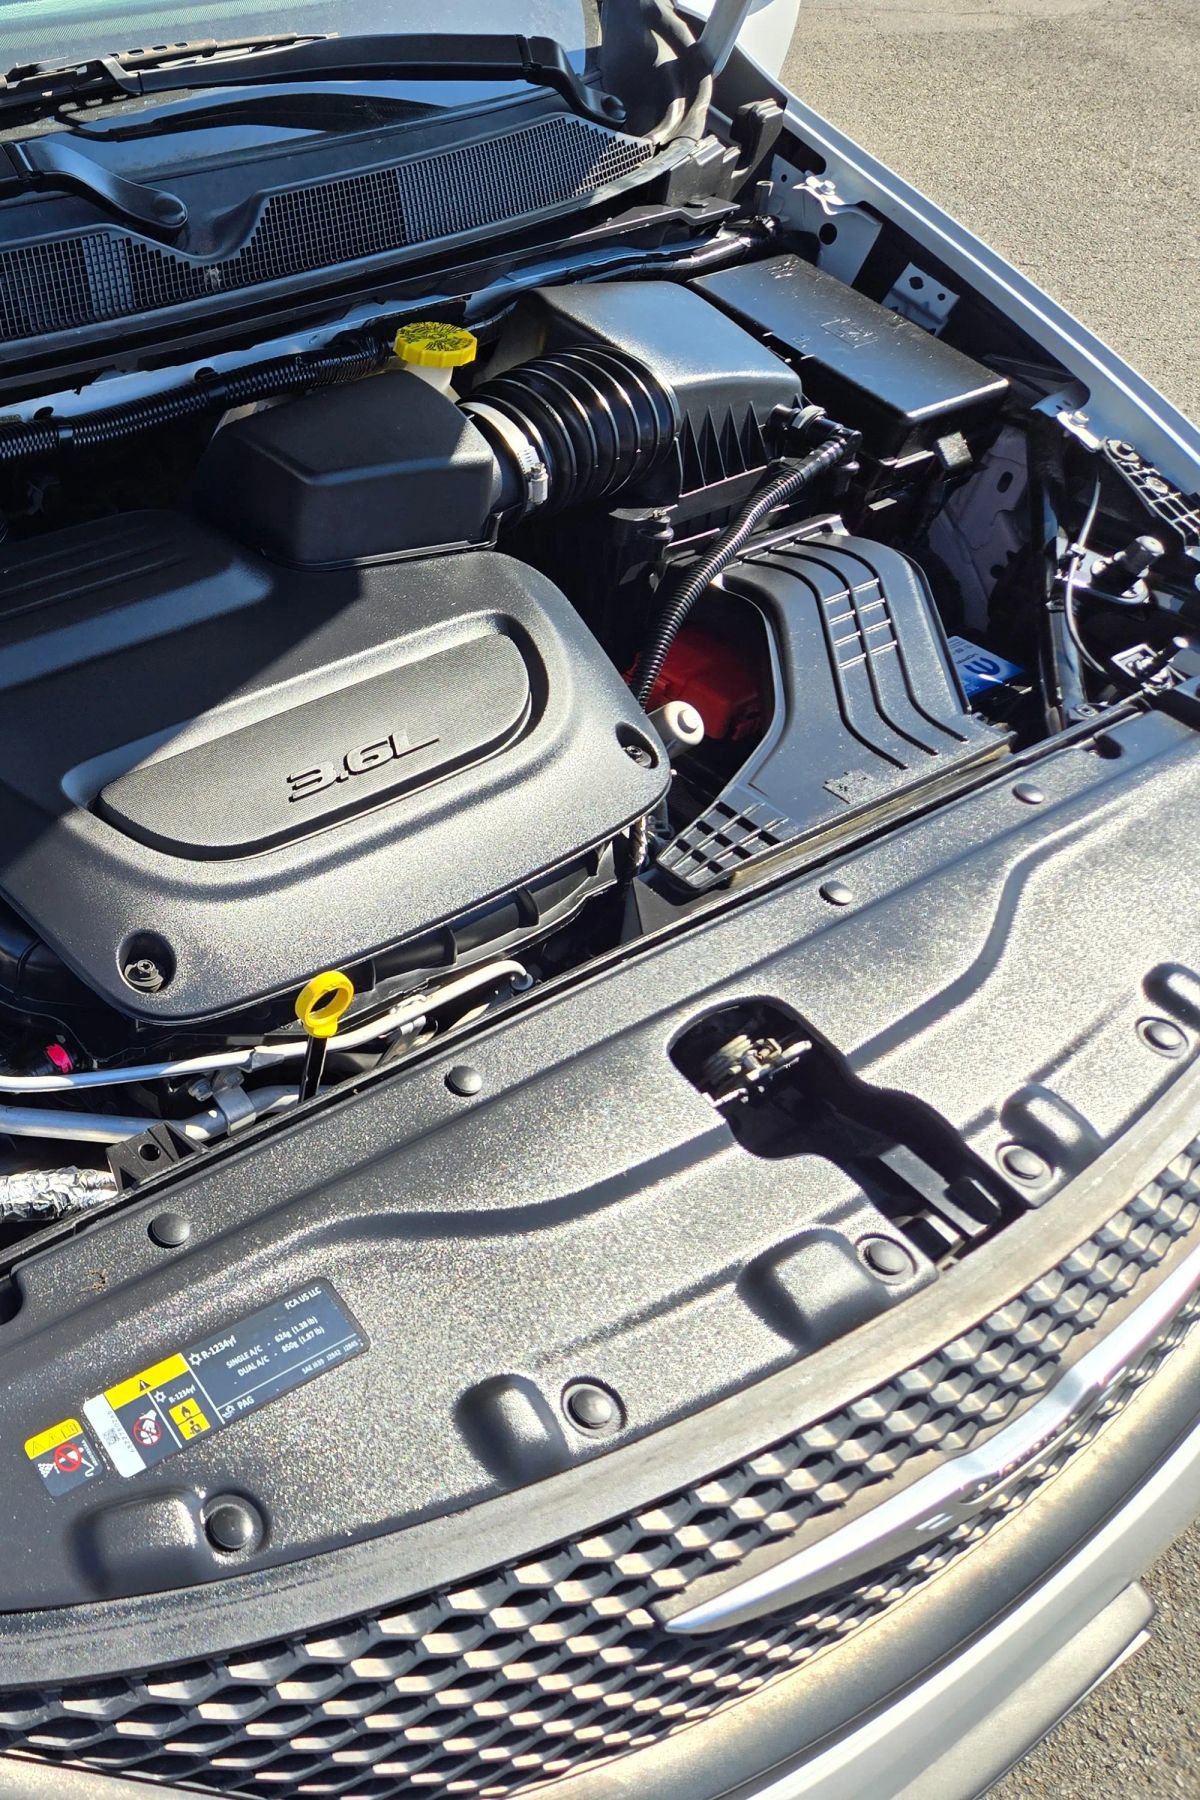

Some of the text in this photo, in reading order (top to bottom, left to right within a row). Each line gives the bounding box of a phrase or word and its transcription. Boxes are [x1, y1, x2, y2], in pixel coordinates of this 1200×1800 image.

[286, 729, 440, 803] 3.6L
[284, 1286, 322, 1310] FCA US LLC
[201, 1335, 237, 1360] R-1234yf
[226, 1352, 250, 1369] SINGLE
[249, 1345, 263, 1357] A/C
[238, 1362, 257, 1376] DUAL
[256, 1355, 270, 1367] A/C
[168, 1384, 196, 1404] R-1234yf
[237, 1396, 255, 1412] PAG
